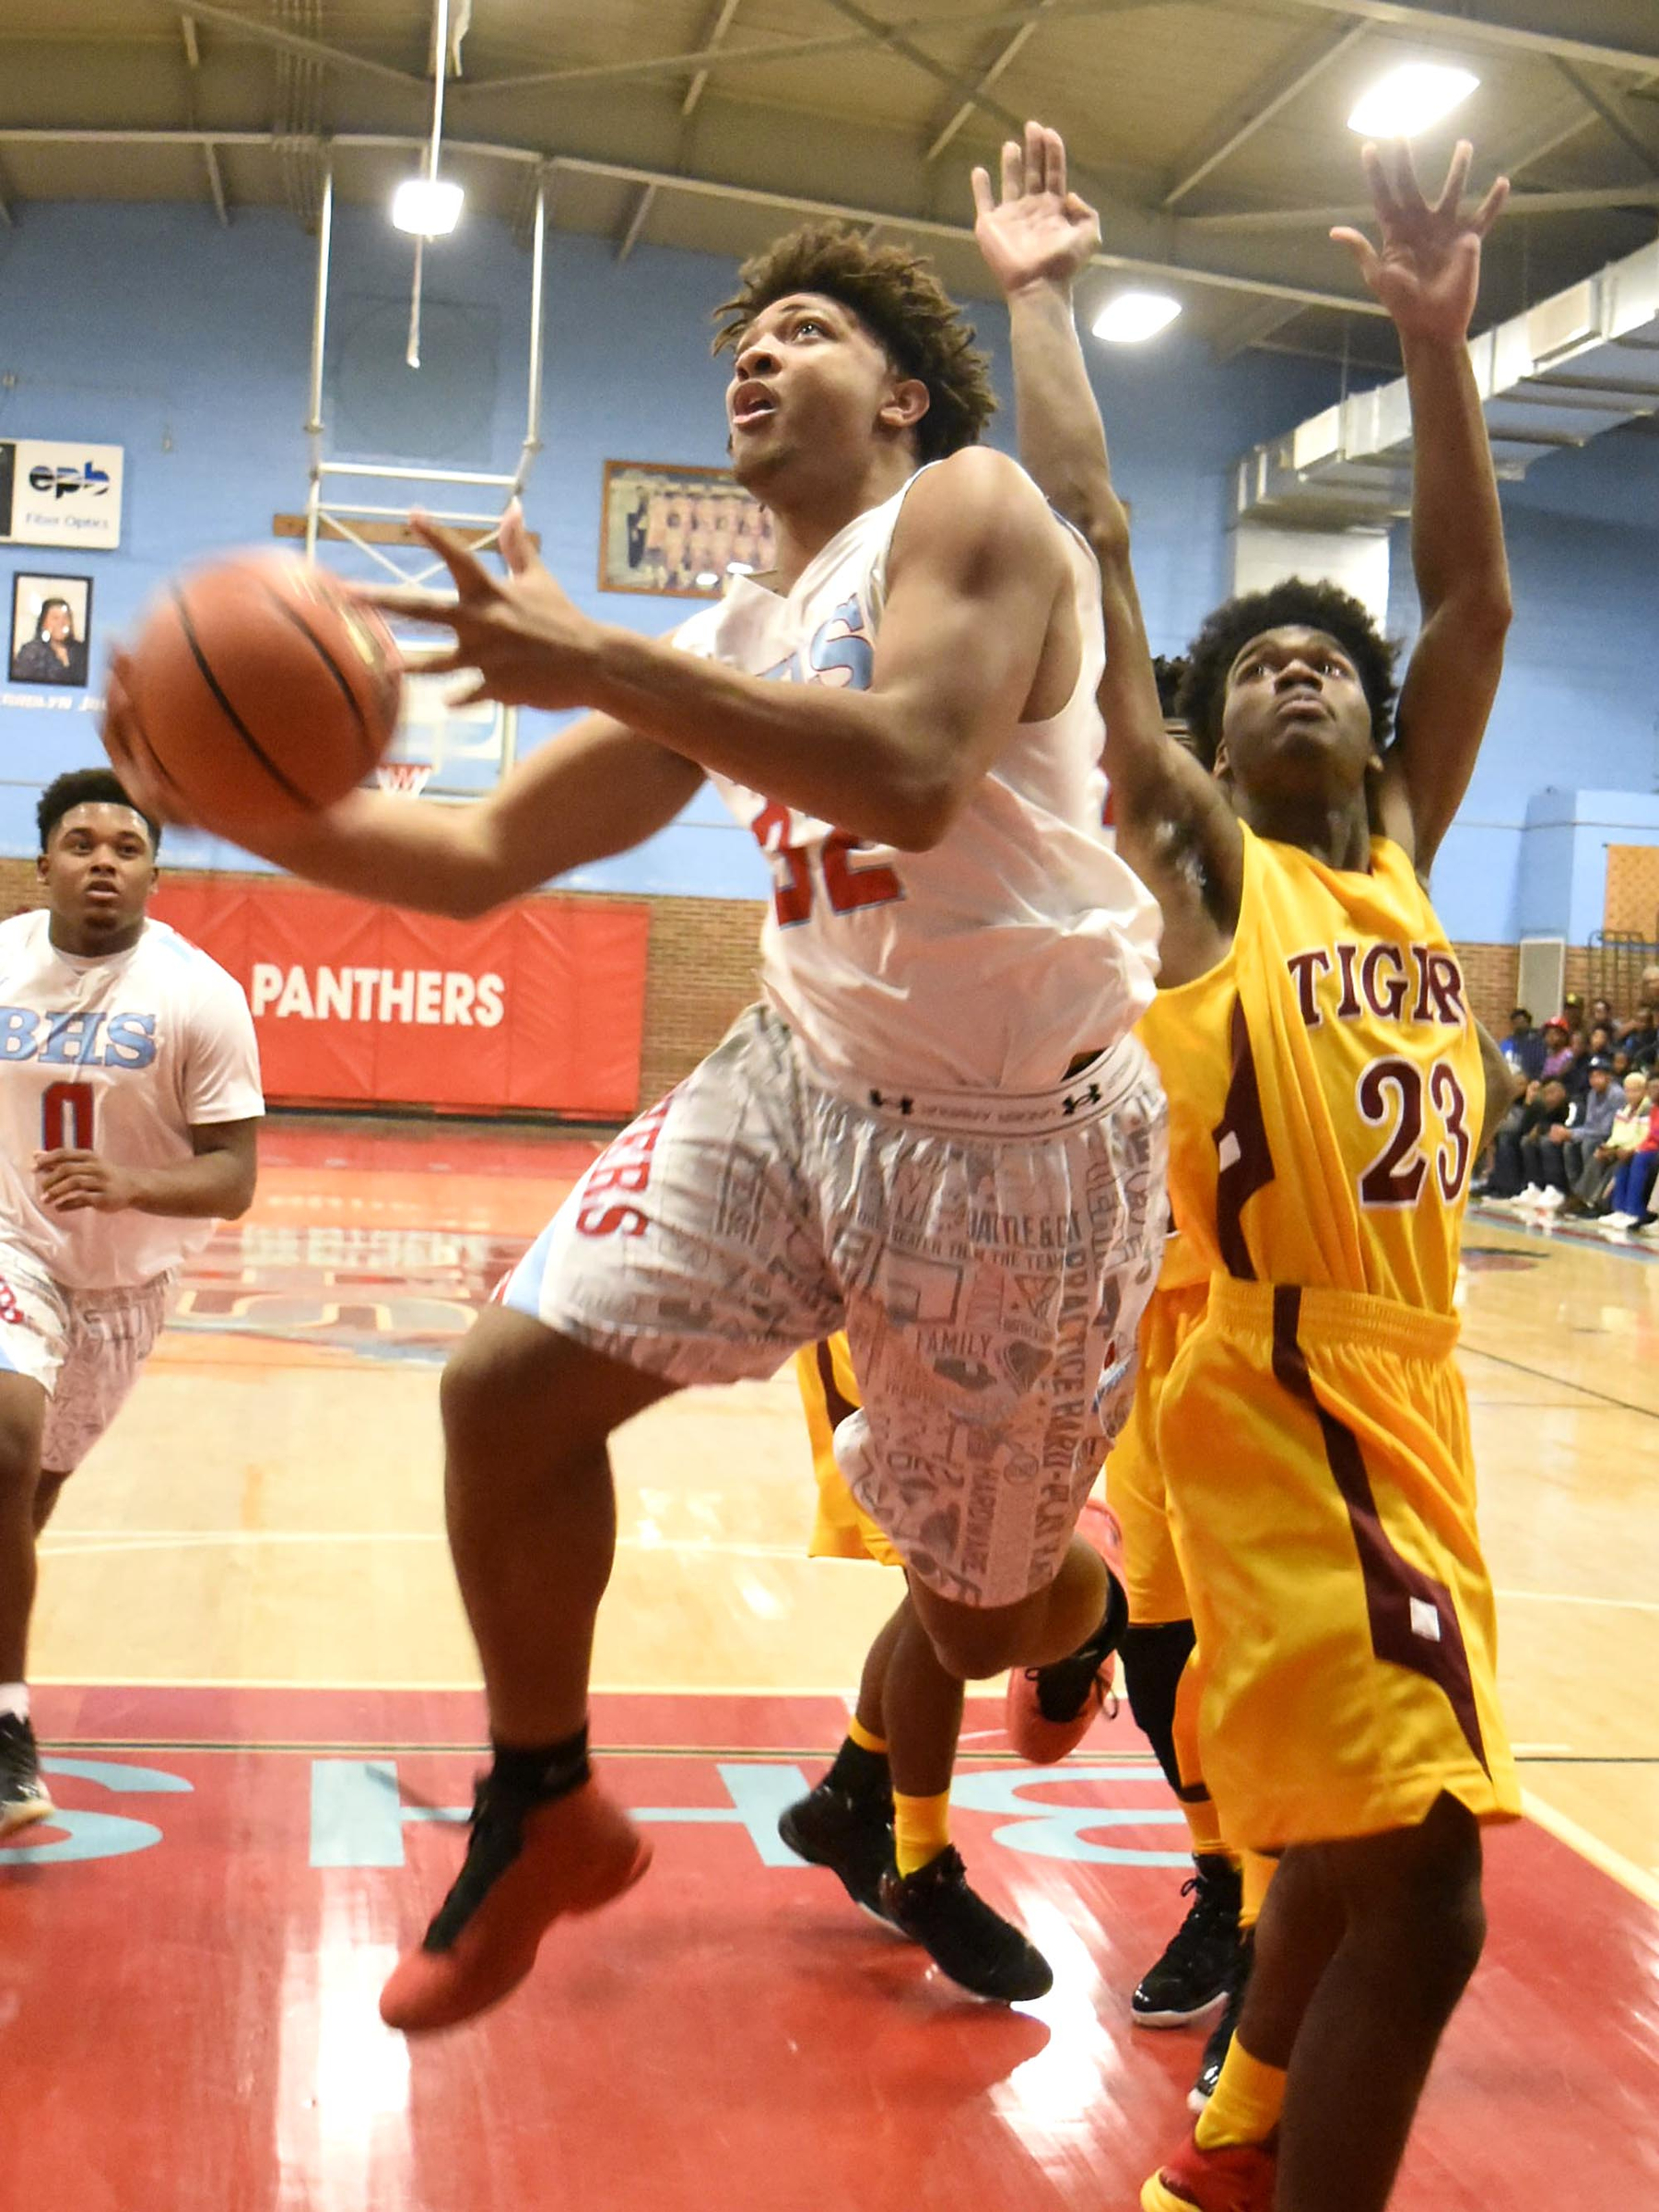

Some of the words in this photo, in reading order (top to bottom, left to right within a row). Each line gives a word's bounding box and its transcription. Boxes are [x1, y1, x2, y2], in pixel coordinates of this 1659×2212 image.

[29, 461, 110, 499] epb
[252, 962, 506, 1028] PANTHERS
[0, 1006, 157, 1069] BHS
[1356, 1055, 1471, 1208] 23
